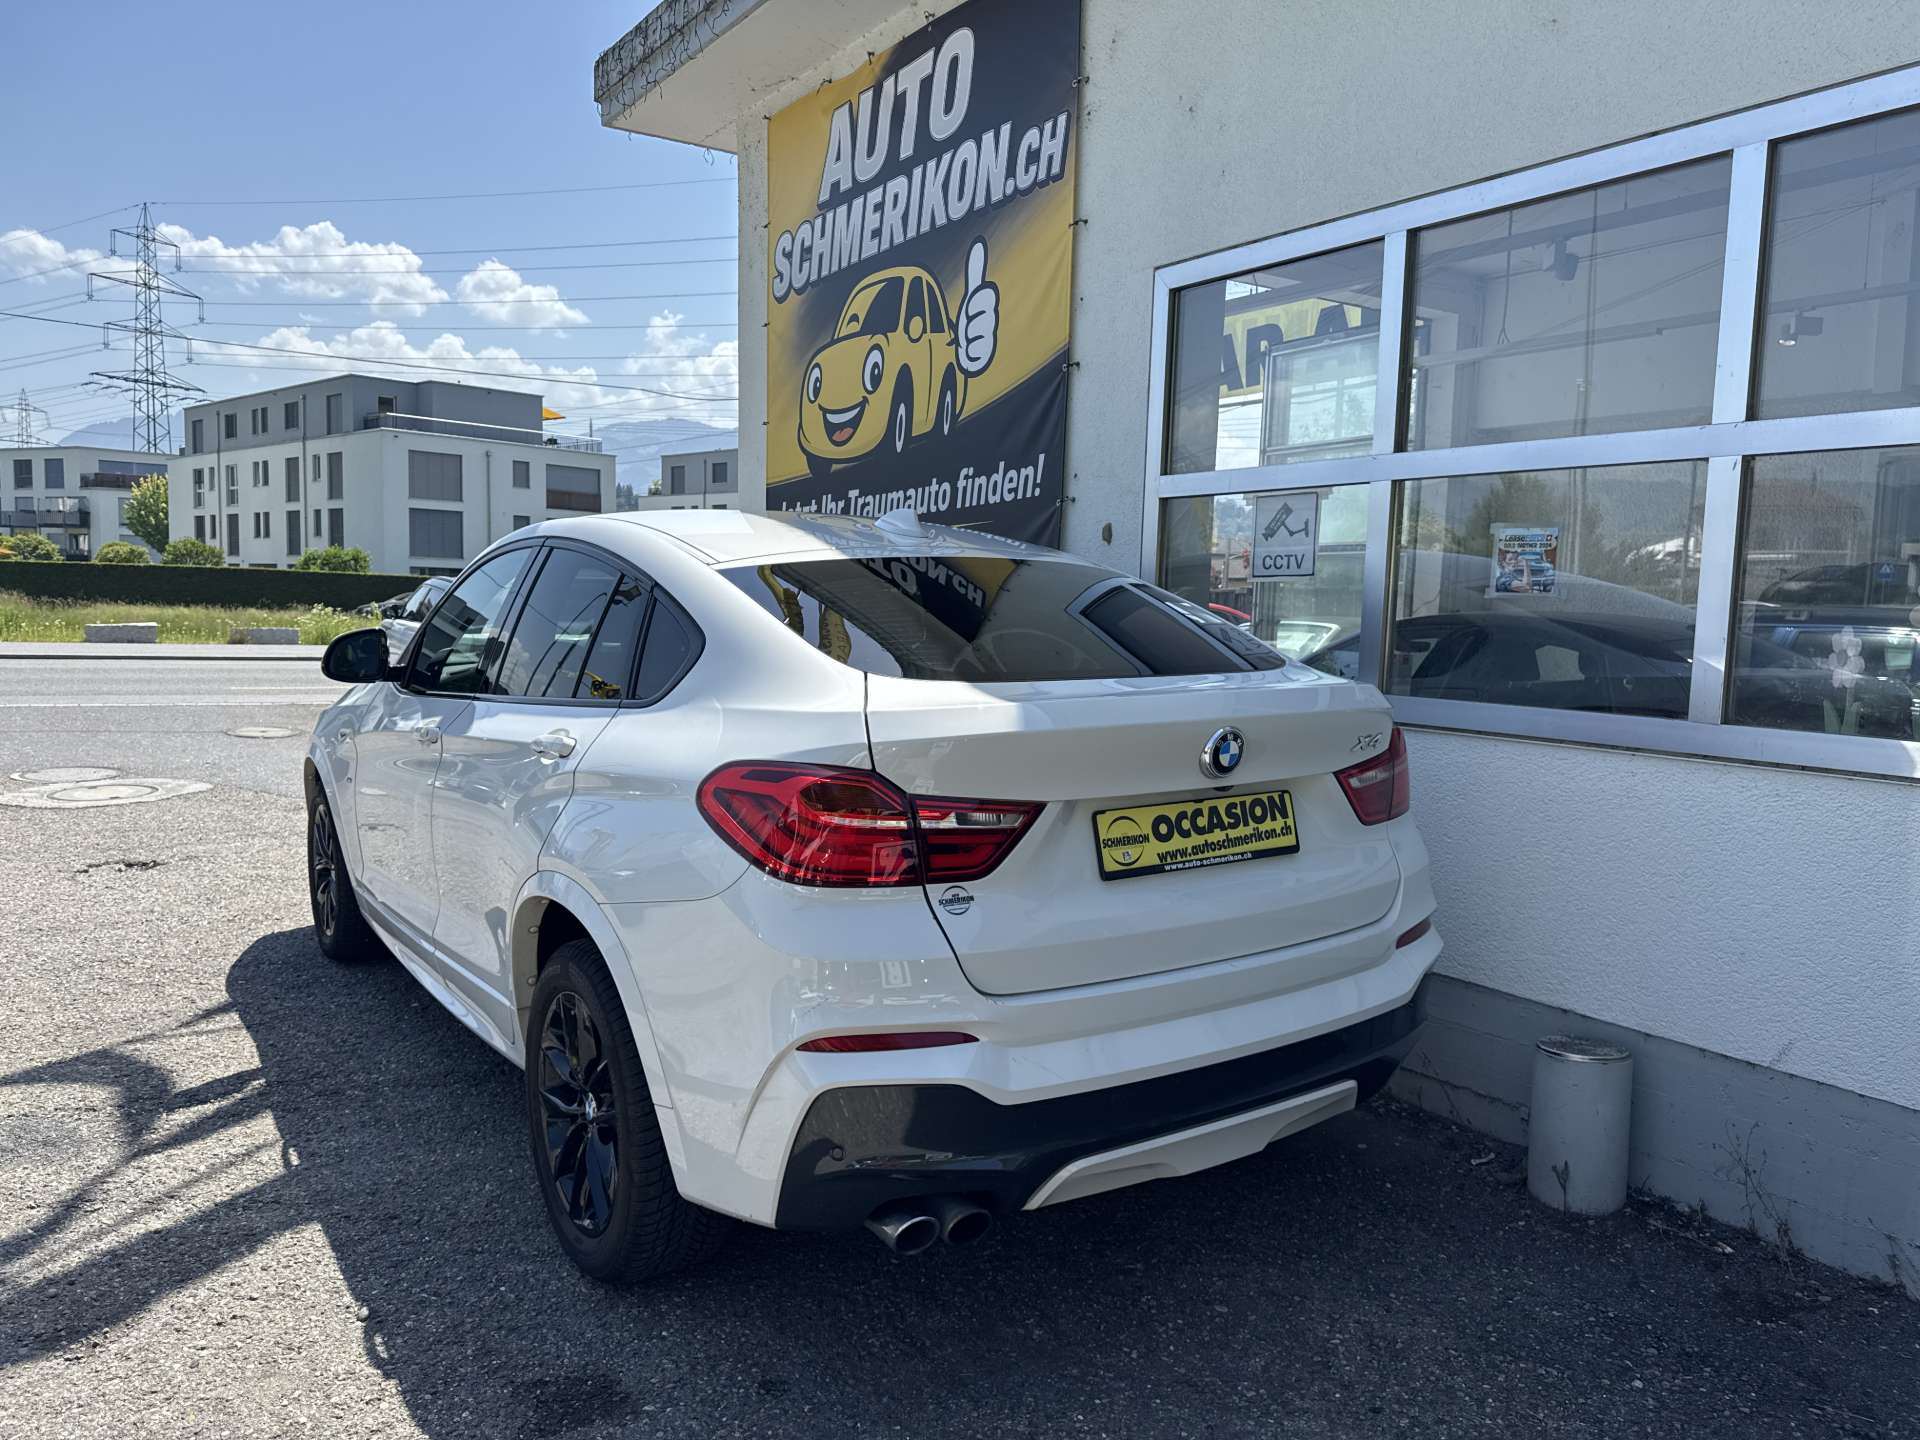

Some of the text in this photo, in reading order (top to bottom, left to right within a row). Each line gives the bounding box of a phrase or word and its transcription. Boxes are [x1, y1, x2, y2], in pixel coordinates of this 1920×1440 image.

[818, 27, 974, 205] AUTO
[773, 112, 1068, 300] SCHMERIKON.CH
[848, 477, 951, 517] Traumauto
[956, 453, 1045, 508] finden!
[1262, 554, 1305, 570] CCTV
[1102, 833, 1149, 849] SCHMERIKON
[1151, 793, 1289, 843] OCCASION
[1156, 821, 1292, 863] www.autoschmerikon.ch
